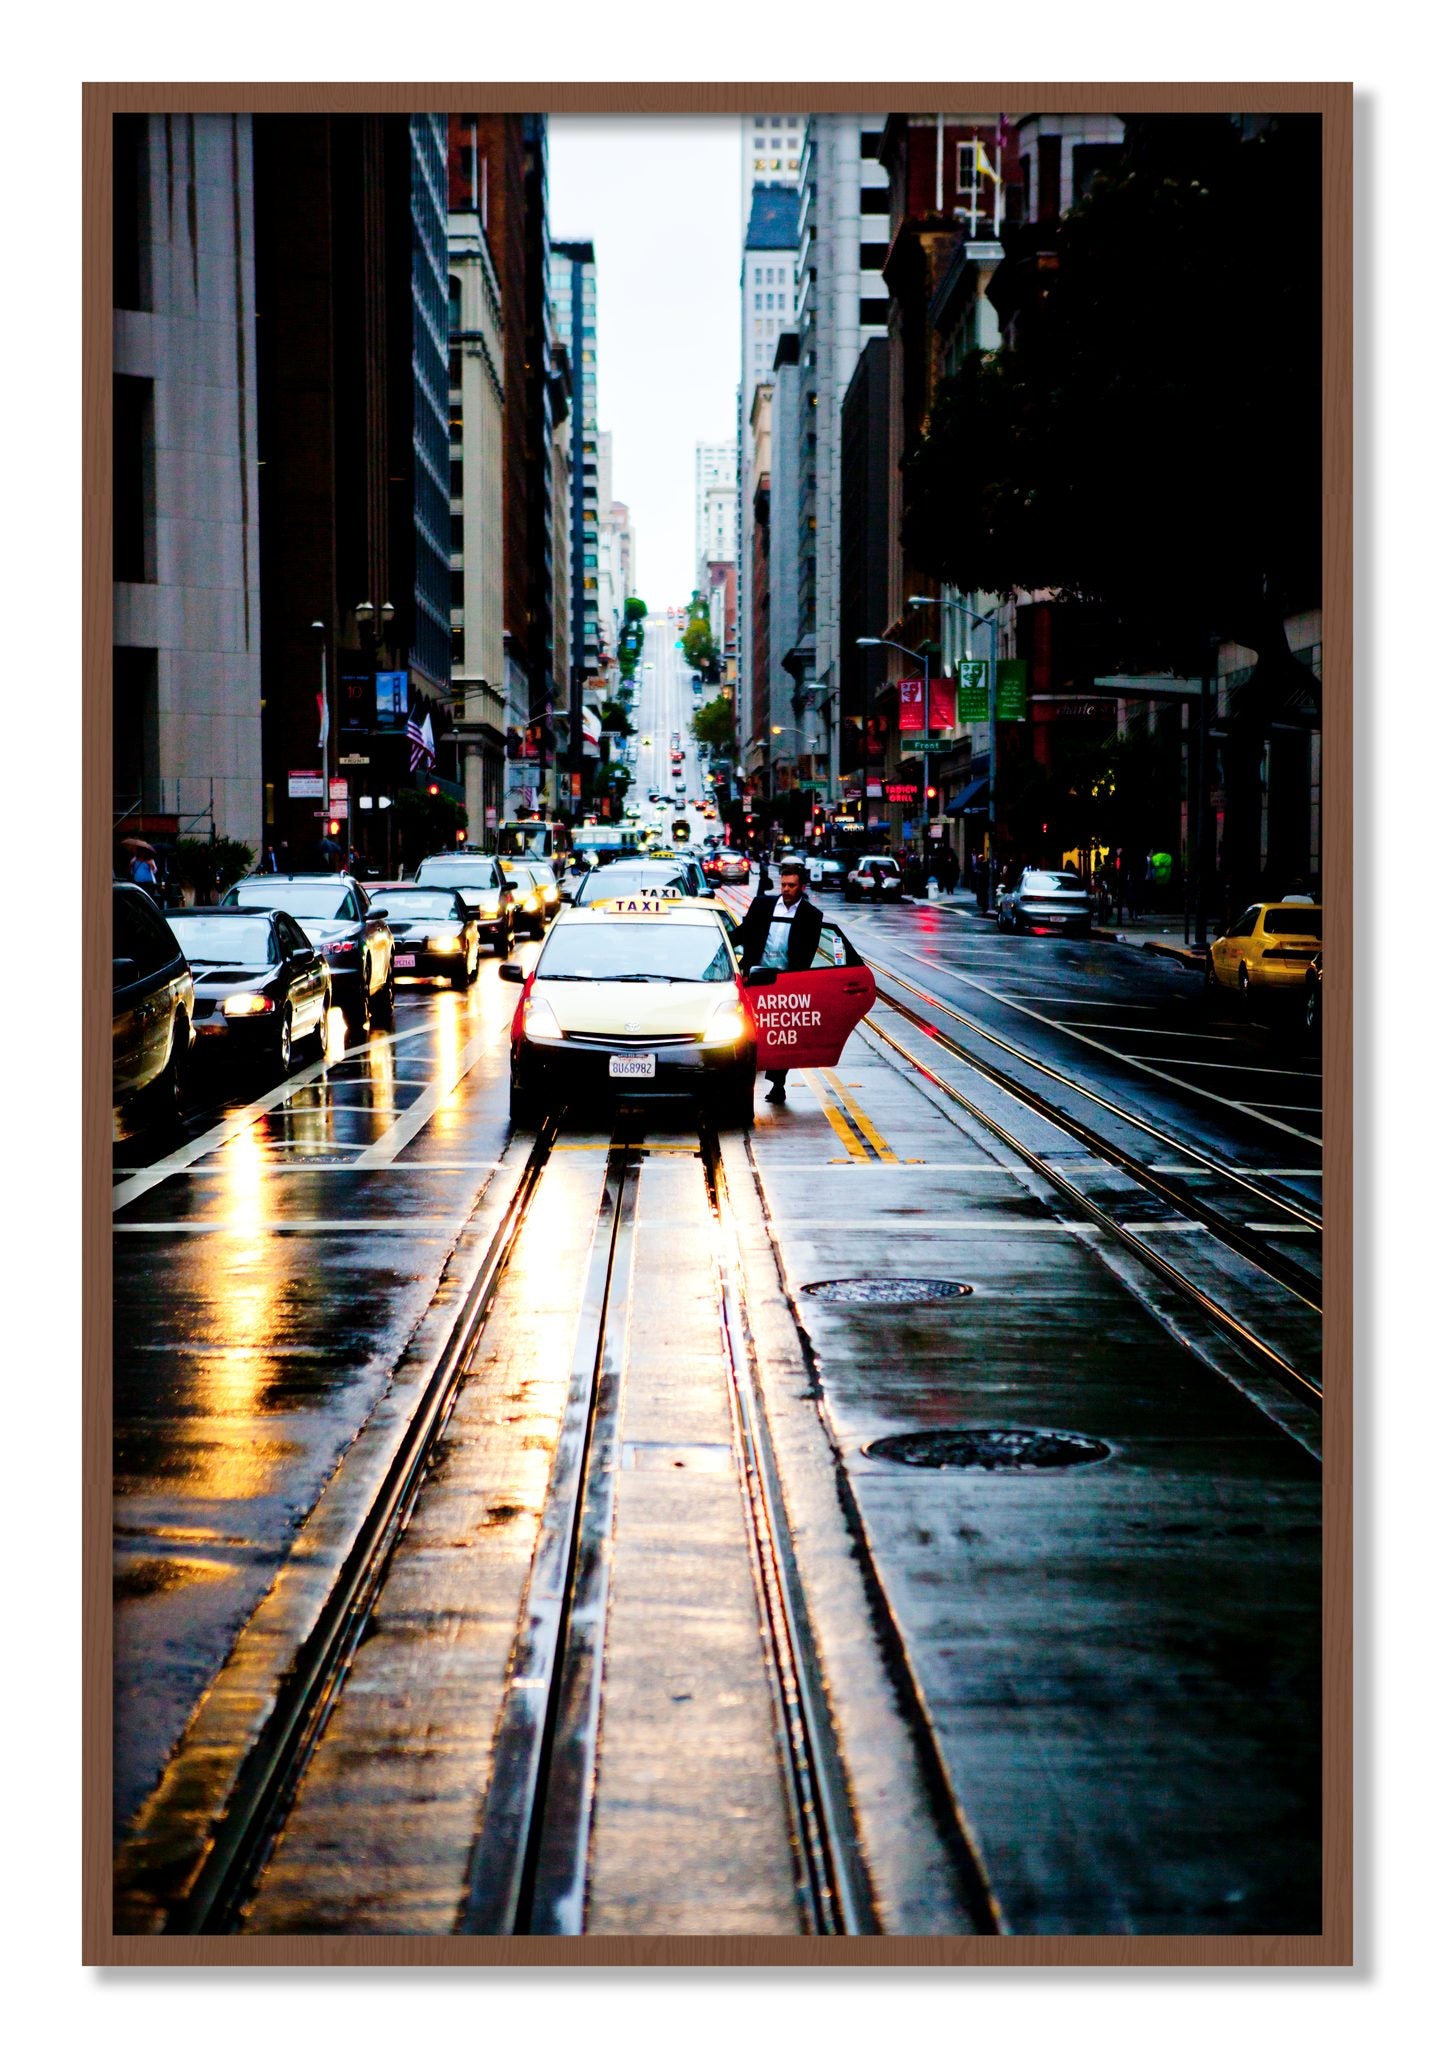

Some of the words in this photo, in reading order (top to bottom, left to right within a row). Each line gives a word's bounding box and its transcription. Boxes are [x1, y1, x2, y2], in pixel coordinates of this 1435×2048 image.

[914, 742, 940, 750] Front
[885, 785, 918, 794] TADICH
[889, 794, 913, 802] GRILL
[641, 889, 676, 897] TAXI
[616, 901, 660, 911] TAXI
[757, 994, 811, 1009] ARROW
[767, 1030, 797, 1045] CAB
[612, 1063, 652, 1073] 8U68982
